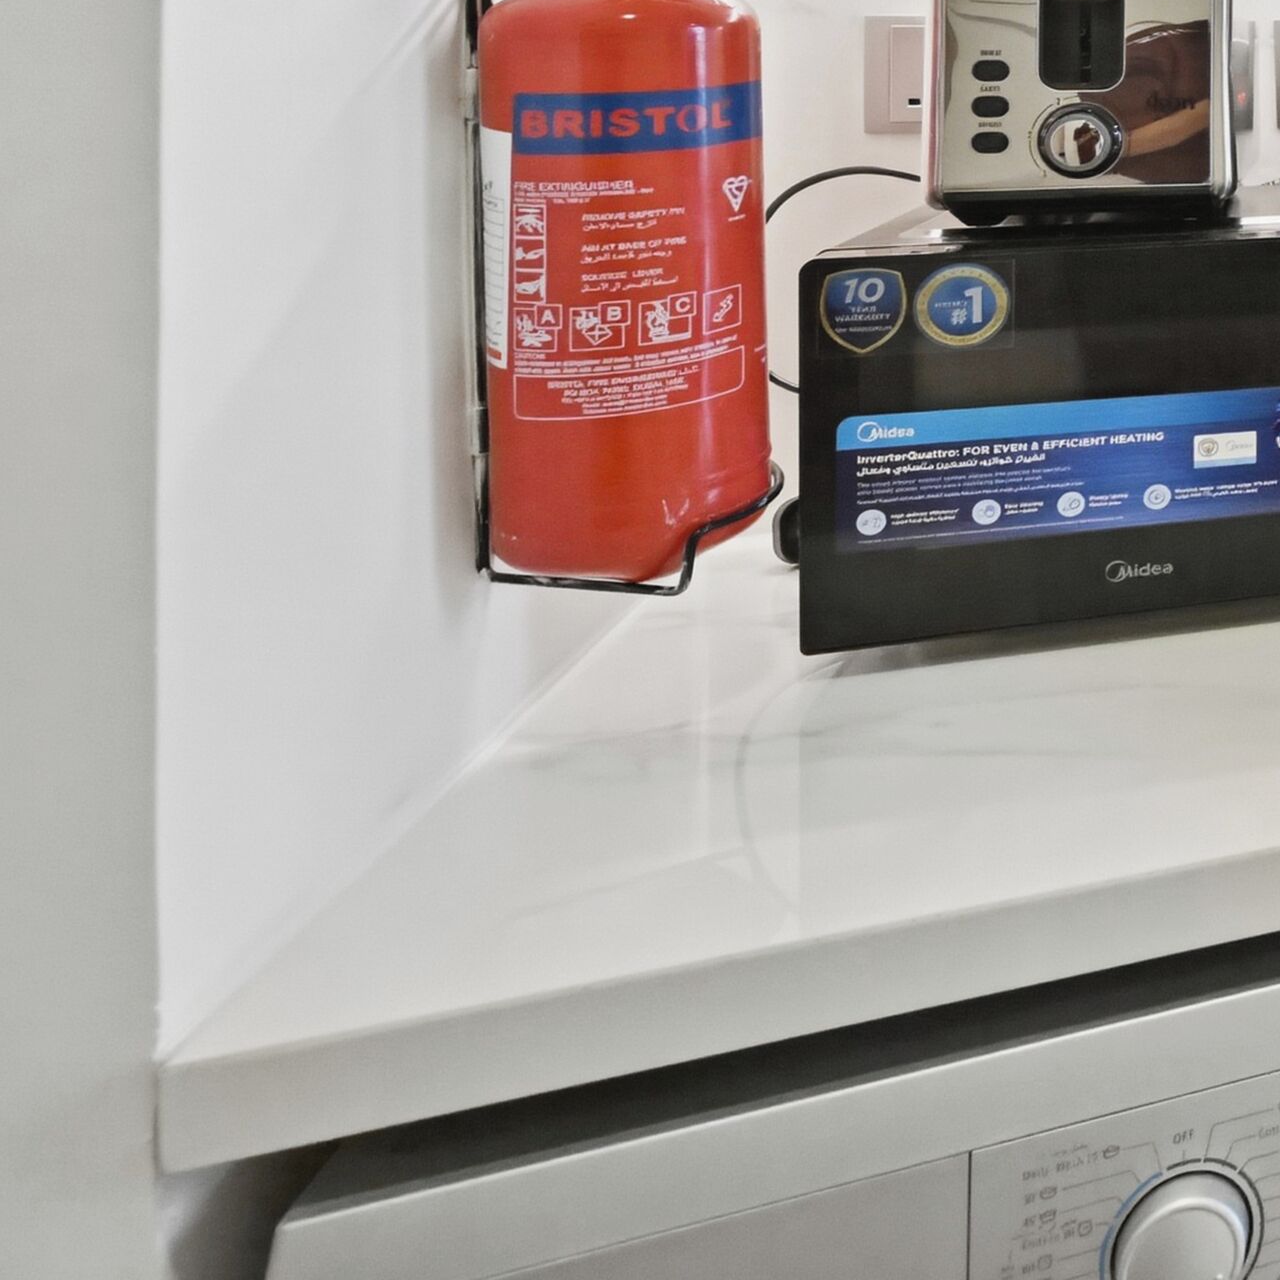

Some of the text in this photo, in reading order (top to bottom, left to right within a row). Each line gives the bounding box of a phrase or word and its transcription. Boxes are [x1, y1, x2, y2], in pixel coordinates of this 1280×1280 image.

[520, 101, 732, 138] BRISTOL
[514, 180, 634, 192] FIRE EXTINGUISHER
[628, 208, 669, 219] SAFETY
[602, 243, 616, 252] AT
[618, 241, 646, 251] BASE
[648, 238, 662, 248] OF
[664, 235, 687, 246] FIRE
[844, 277, 886, 304] 10
[675, 297, 690, 313] C
[851, 305, 877, 314] YEAR
[540, 309, 556, 325] A
[607, 306, 622, 322] B
[834, 312, 891, 323] WARRANTY
[857, 421, 915, 442] Midea
[856, 448, 960, 464] InverterQuattro:
[963, 444, 990, 456] FOR
[993, 441, 1028, 454] EVEN
[1043, 435, 1107, 451] EFFICIENT
[1110, 431, 1165, 445] HEATING
[1105, 560, 1174, 582] Midea
